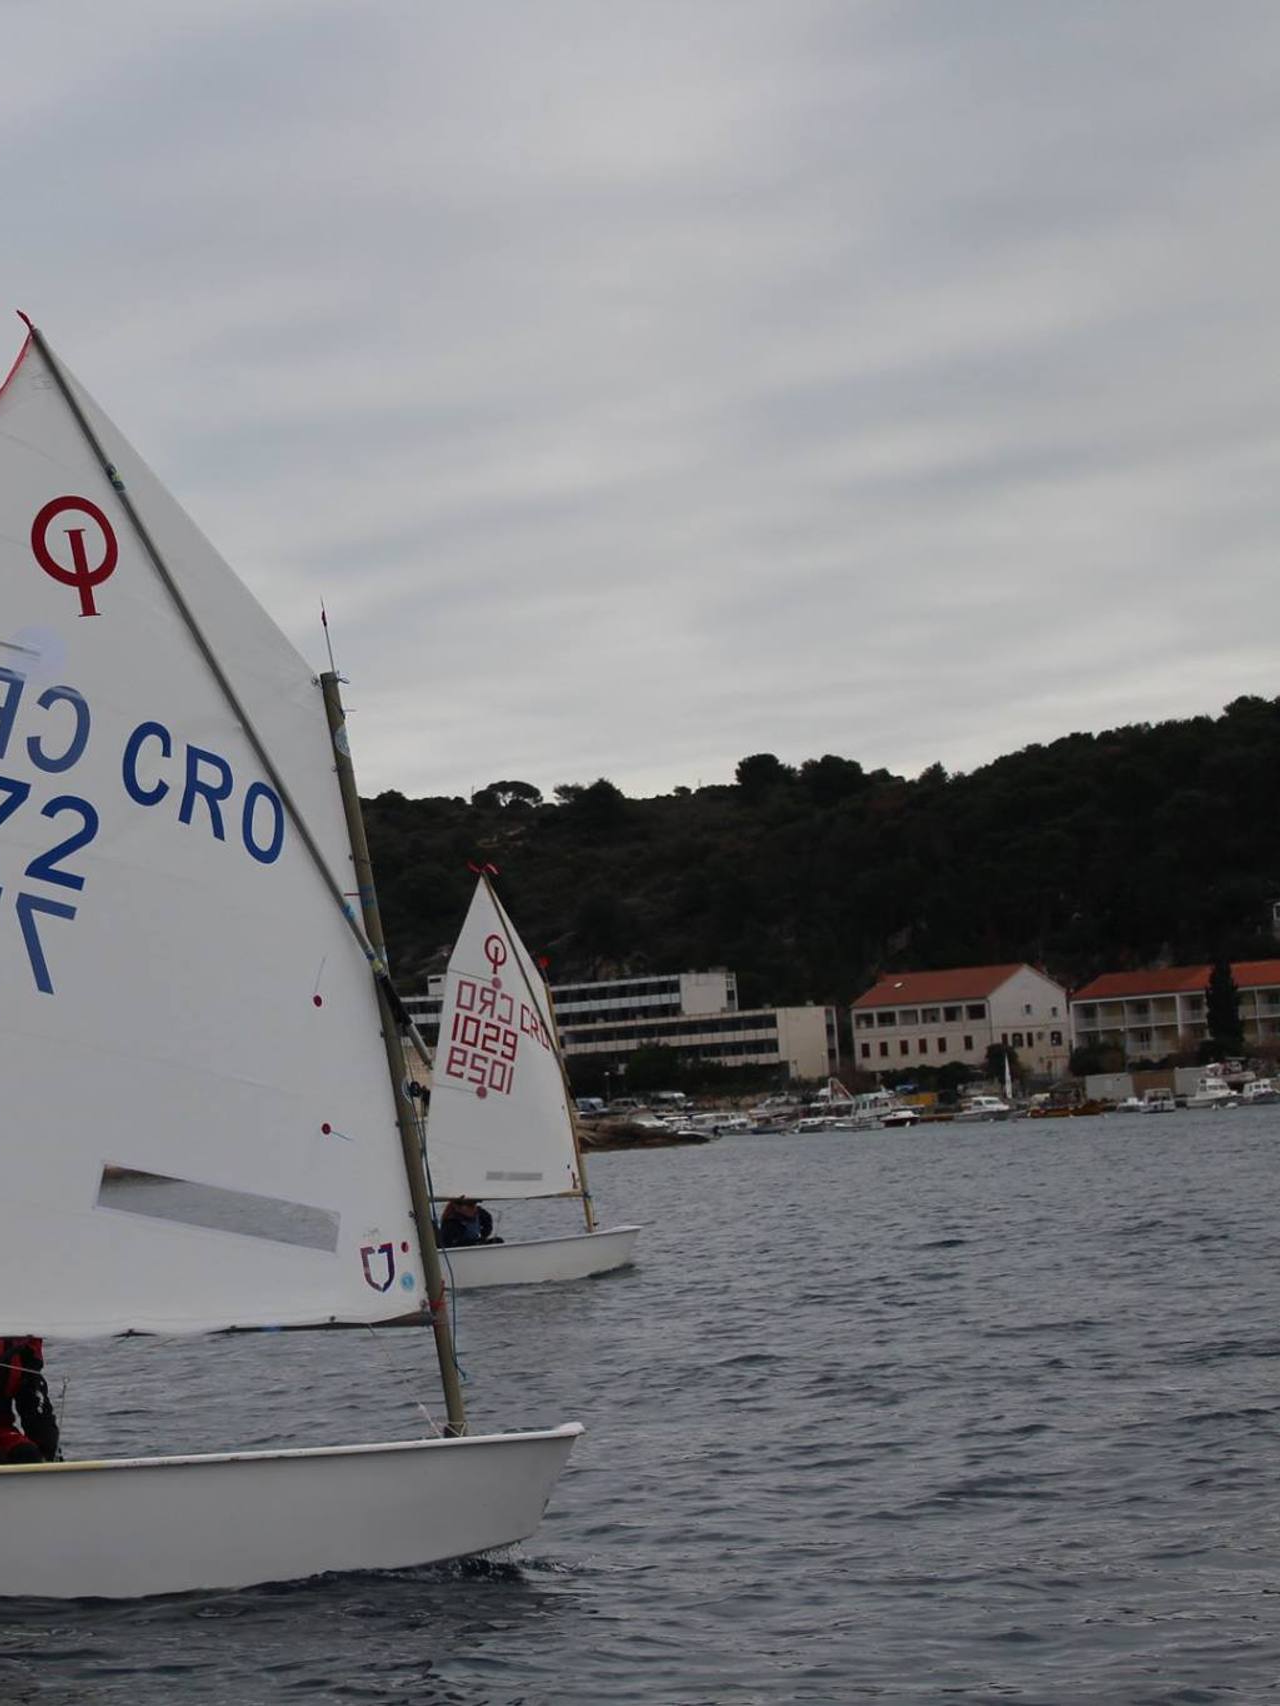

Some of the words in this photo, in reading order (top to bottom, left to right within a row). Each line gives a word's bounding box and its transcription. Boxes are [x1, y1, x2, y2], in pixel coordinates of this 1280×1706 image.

[122, 721, 285, 864] CRO
[451, 1012, 518, 1062] 1029
[520, 1002, 550, 1051] CRO
